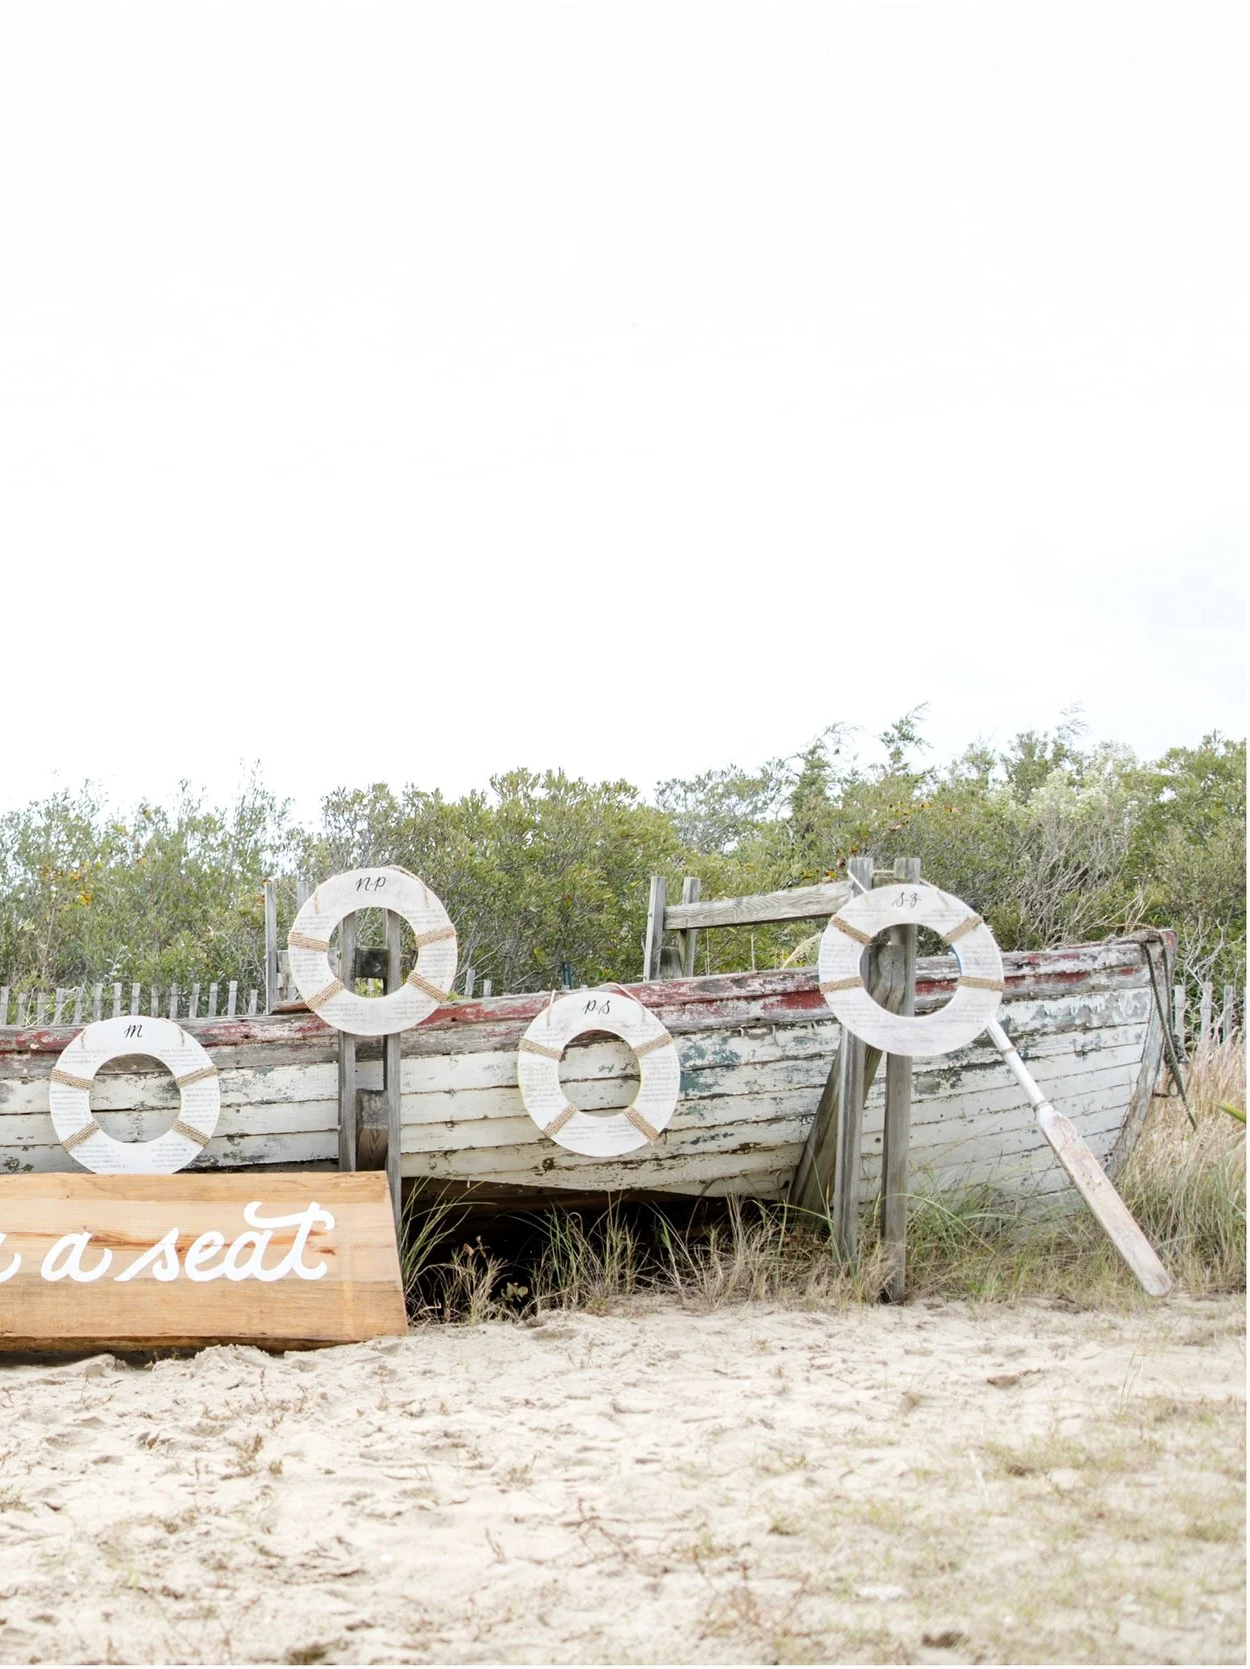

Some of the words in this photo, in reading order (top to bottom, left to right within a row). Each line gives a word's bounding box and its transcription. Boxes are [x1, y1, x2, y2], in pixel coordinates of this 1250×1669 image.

[122, 1023, 144, 1039] M
[38, 1231, 116, 1284] a
[113, 1200, 342, 1283] seat
